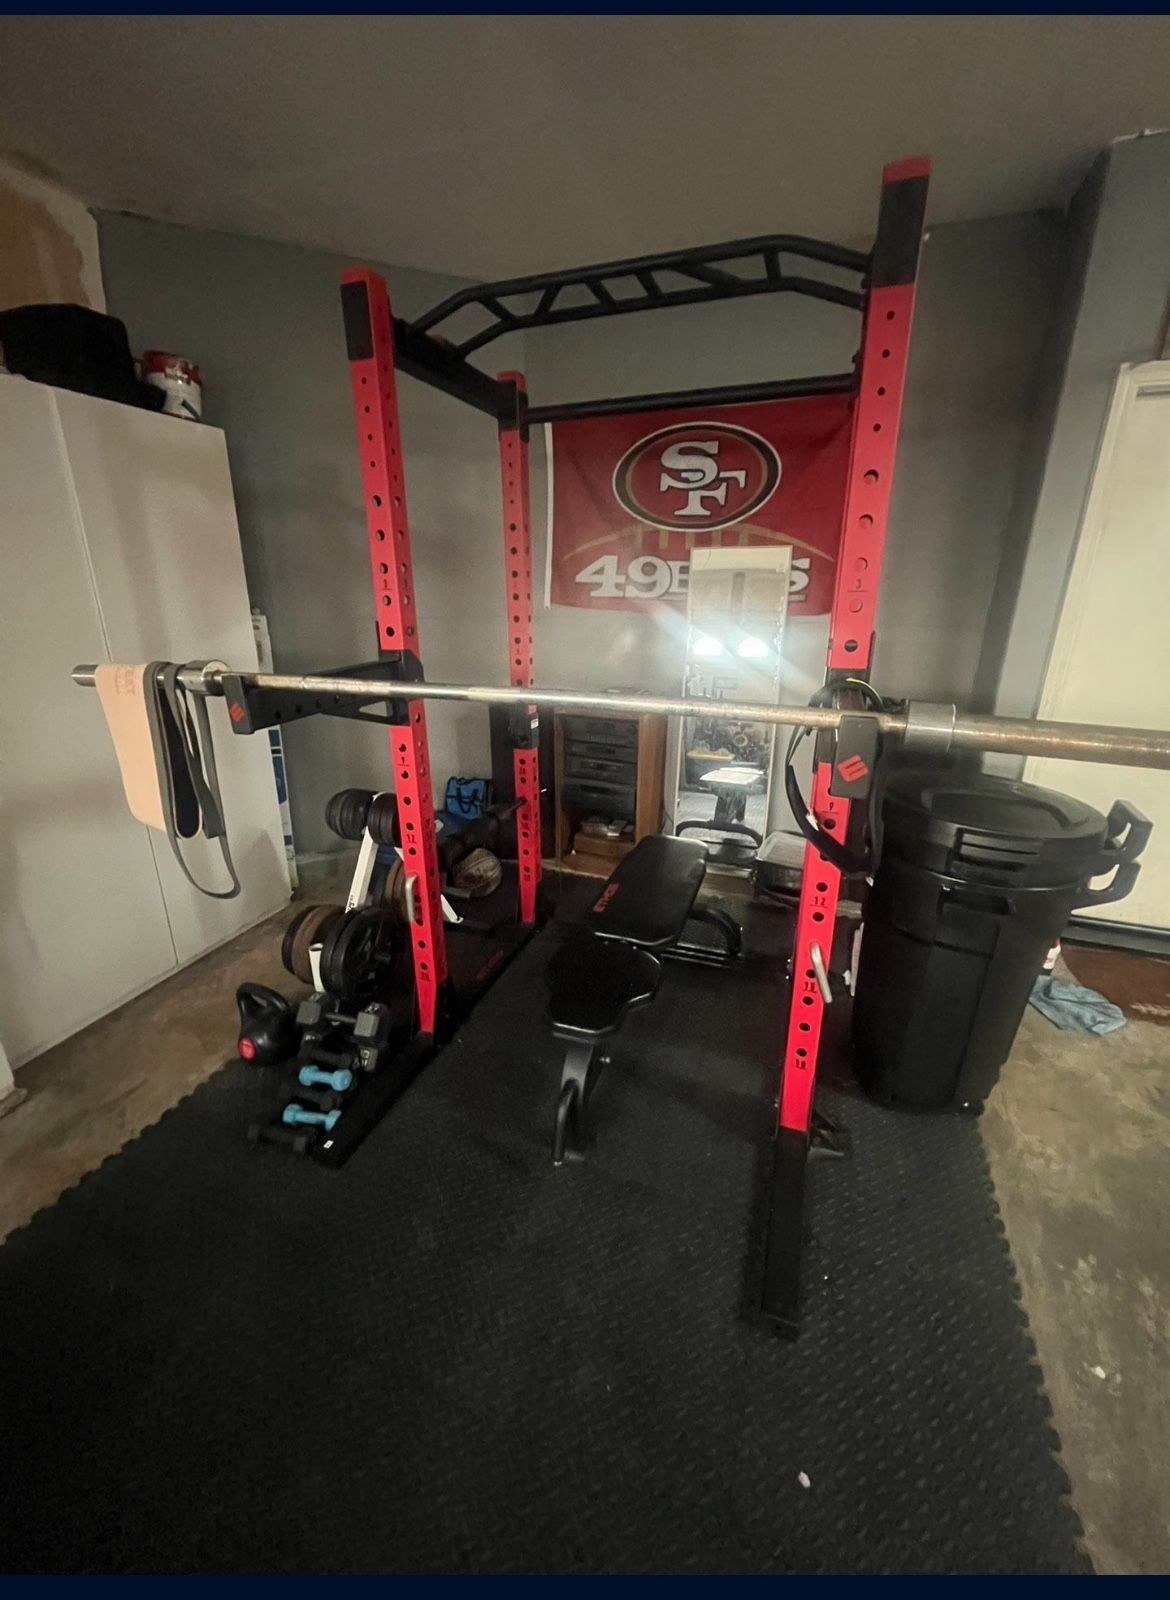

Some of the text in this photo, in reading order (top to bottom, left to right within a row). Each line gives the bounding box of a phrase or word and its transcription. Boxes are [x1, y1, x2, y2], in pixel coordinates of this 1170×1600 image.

[659, 440, 747, 516] SF
[575, 554, 811, 598] 49ES
[813, 895, 826, 906] 12
